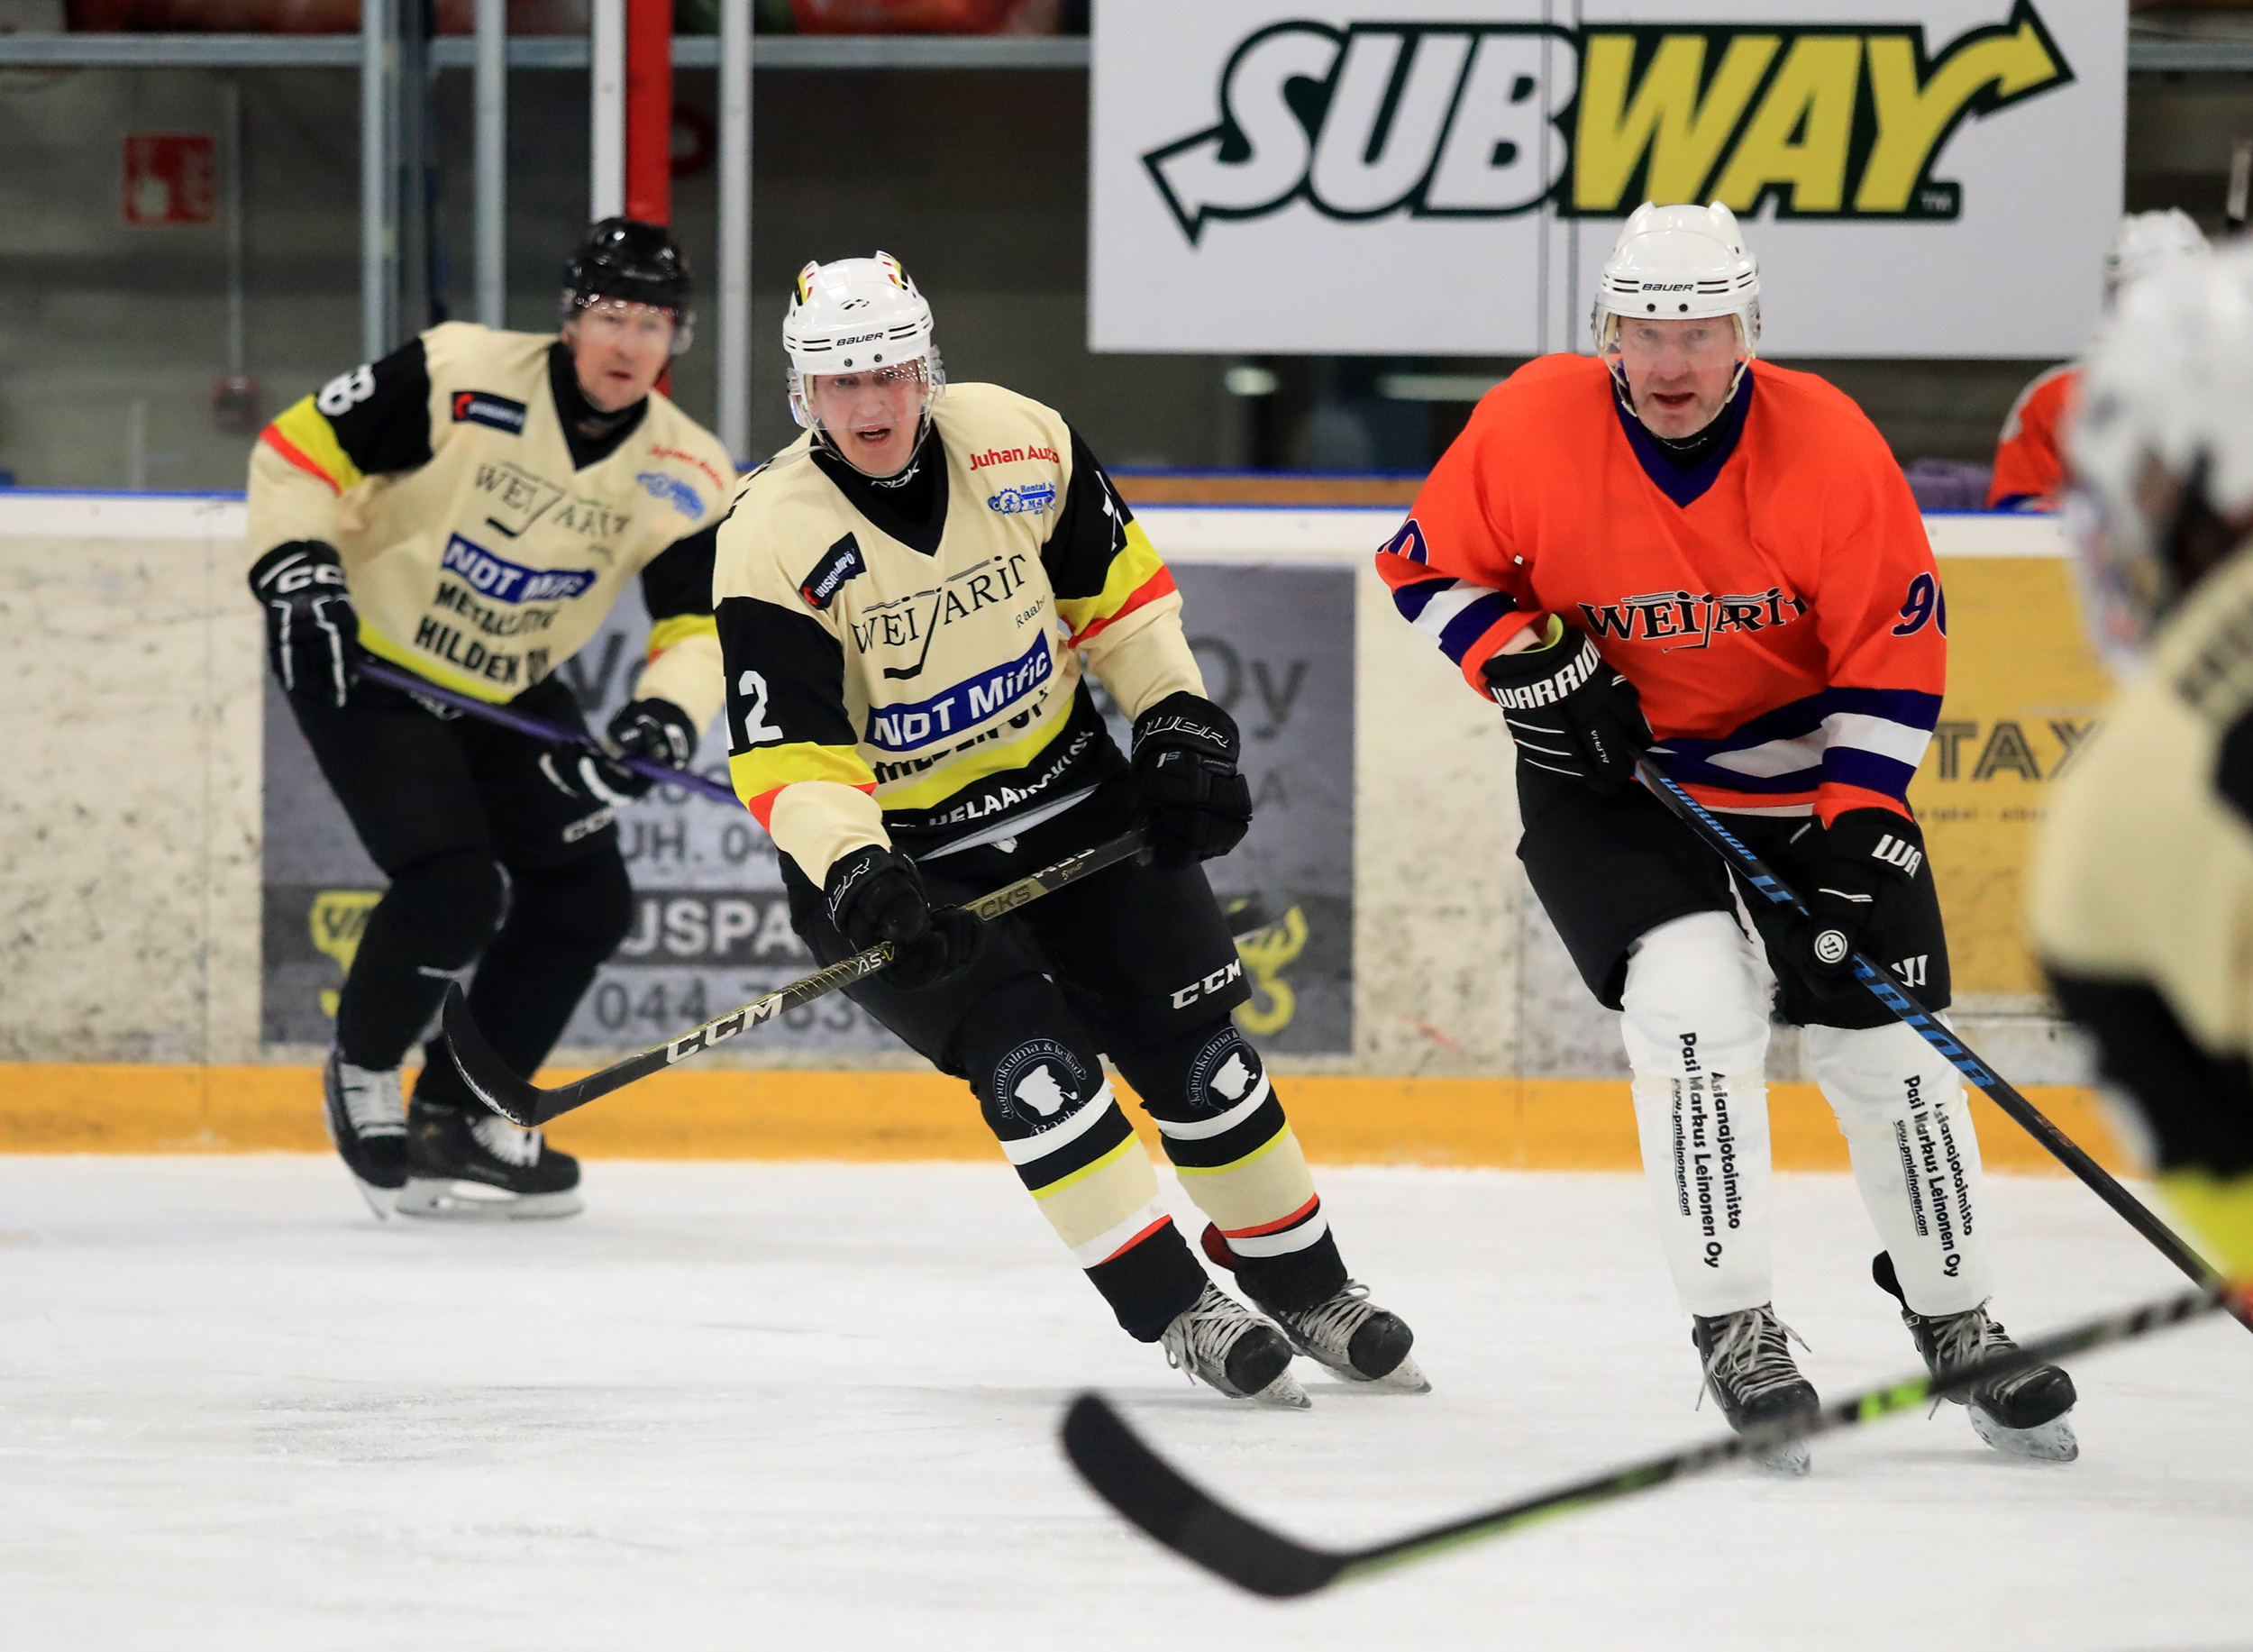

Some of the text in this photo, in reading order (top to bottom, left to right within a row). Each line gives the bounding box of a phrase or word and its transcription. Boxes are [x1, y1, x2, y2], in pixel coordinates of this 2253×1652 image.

[1142, 0, 2076, 246] SUBWAY
[1641, 283, 1695, 292] BAUER
[835, 332, 884, 347] BAUER
[969, 444, 1060, 471] Juhan Auto
[276, 562, 348, 595] CC
[967, 651, 1049, 720] Mific
[1491, 632, 1601, 710] WARRIO
[1659, 777, 1757, 861] WARRIOR
[981, 884, 1031, 919] CKS
[1169, 957, 1243, 1010] CCM
[665, 991, 783, 1065] CCM
[1679, 1031, 1723, 1269] Pasi Markus Leinonen Oy
[1903, 1074, 1926, 1109] Pasi
[1929, 1175, 1955, 1251] Leinonen
[1943, 1253, 1961, 1278] Oy
